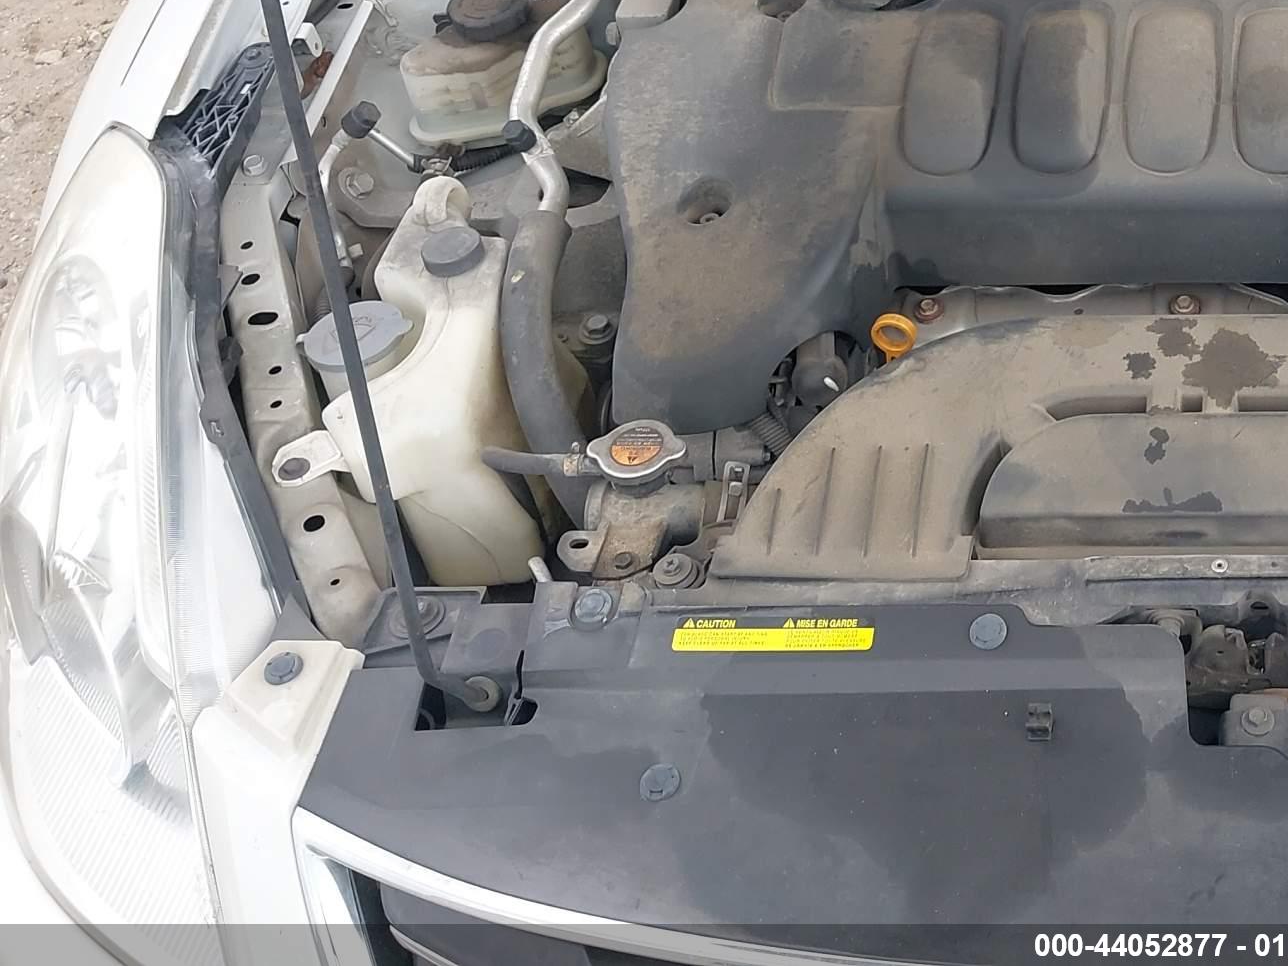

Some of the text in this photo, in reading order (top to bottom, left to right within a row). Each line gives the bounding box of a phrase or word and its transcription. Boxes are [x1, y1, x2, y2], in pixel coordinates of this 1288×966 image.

[696, 619, 736, 628] CAUTION
[796, 618, 858, 628] MISE EN GARDE
